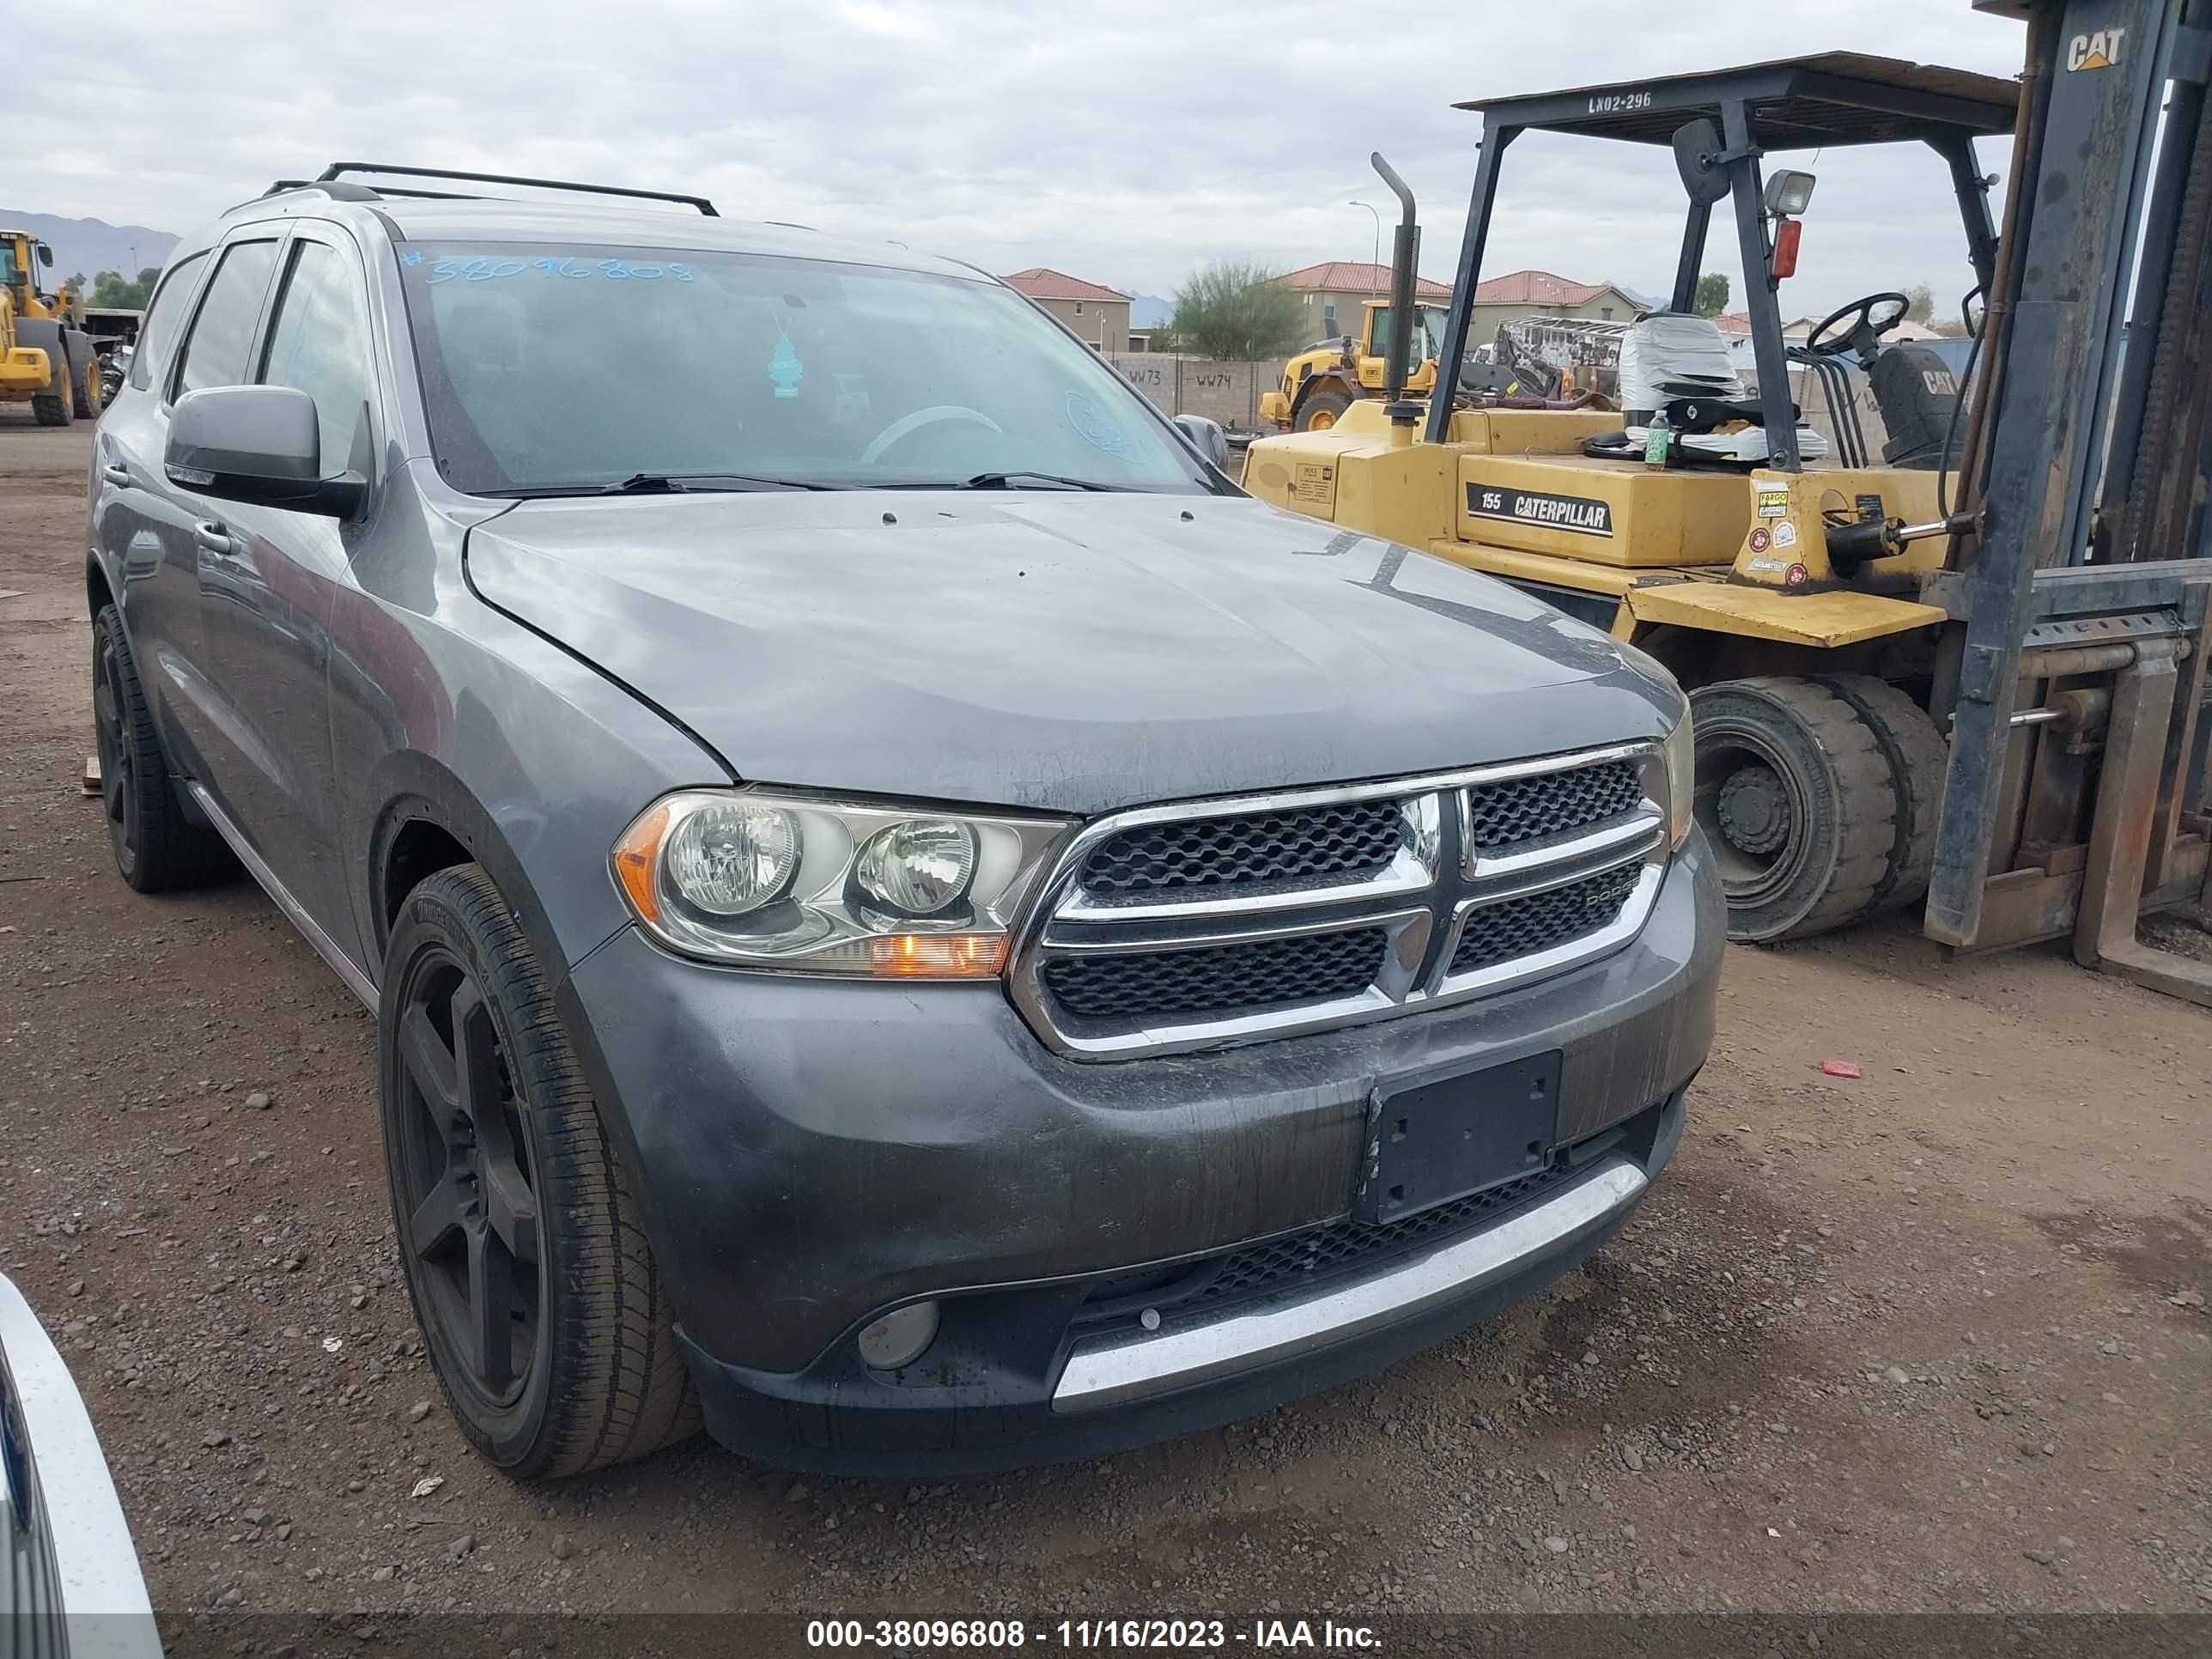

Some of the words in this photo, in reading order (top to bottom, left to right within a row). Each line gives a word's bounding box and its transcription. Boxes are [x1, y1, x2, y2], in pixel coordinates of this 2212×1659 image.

[2067, 28, 2124, 71] CAT
[1129, 370, 1161, 385] WW73
[1923, 371, 1956, 395] CAT
[1761, 493, 1787, 501] FARGO
[1482, 492, 1502, 510] 155
[1515, 496, 1607, 528] CATERPILLAR
